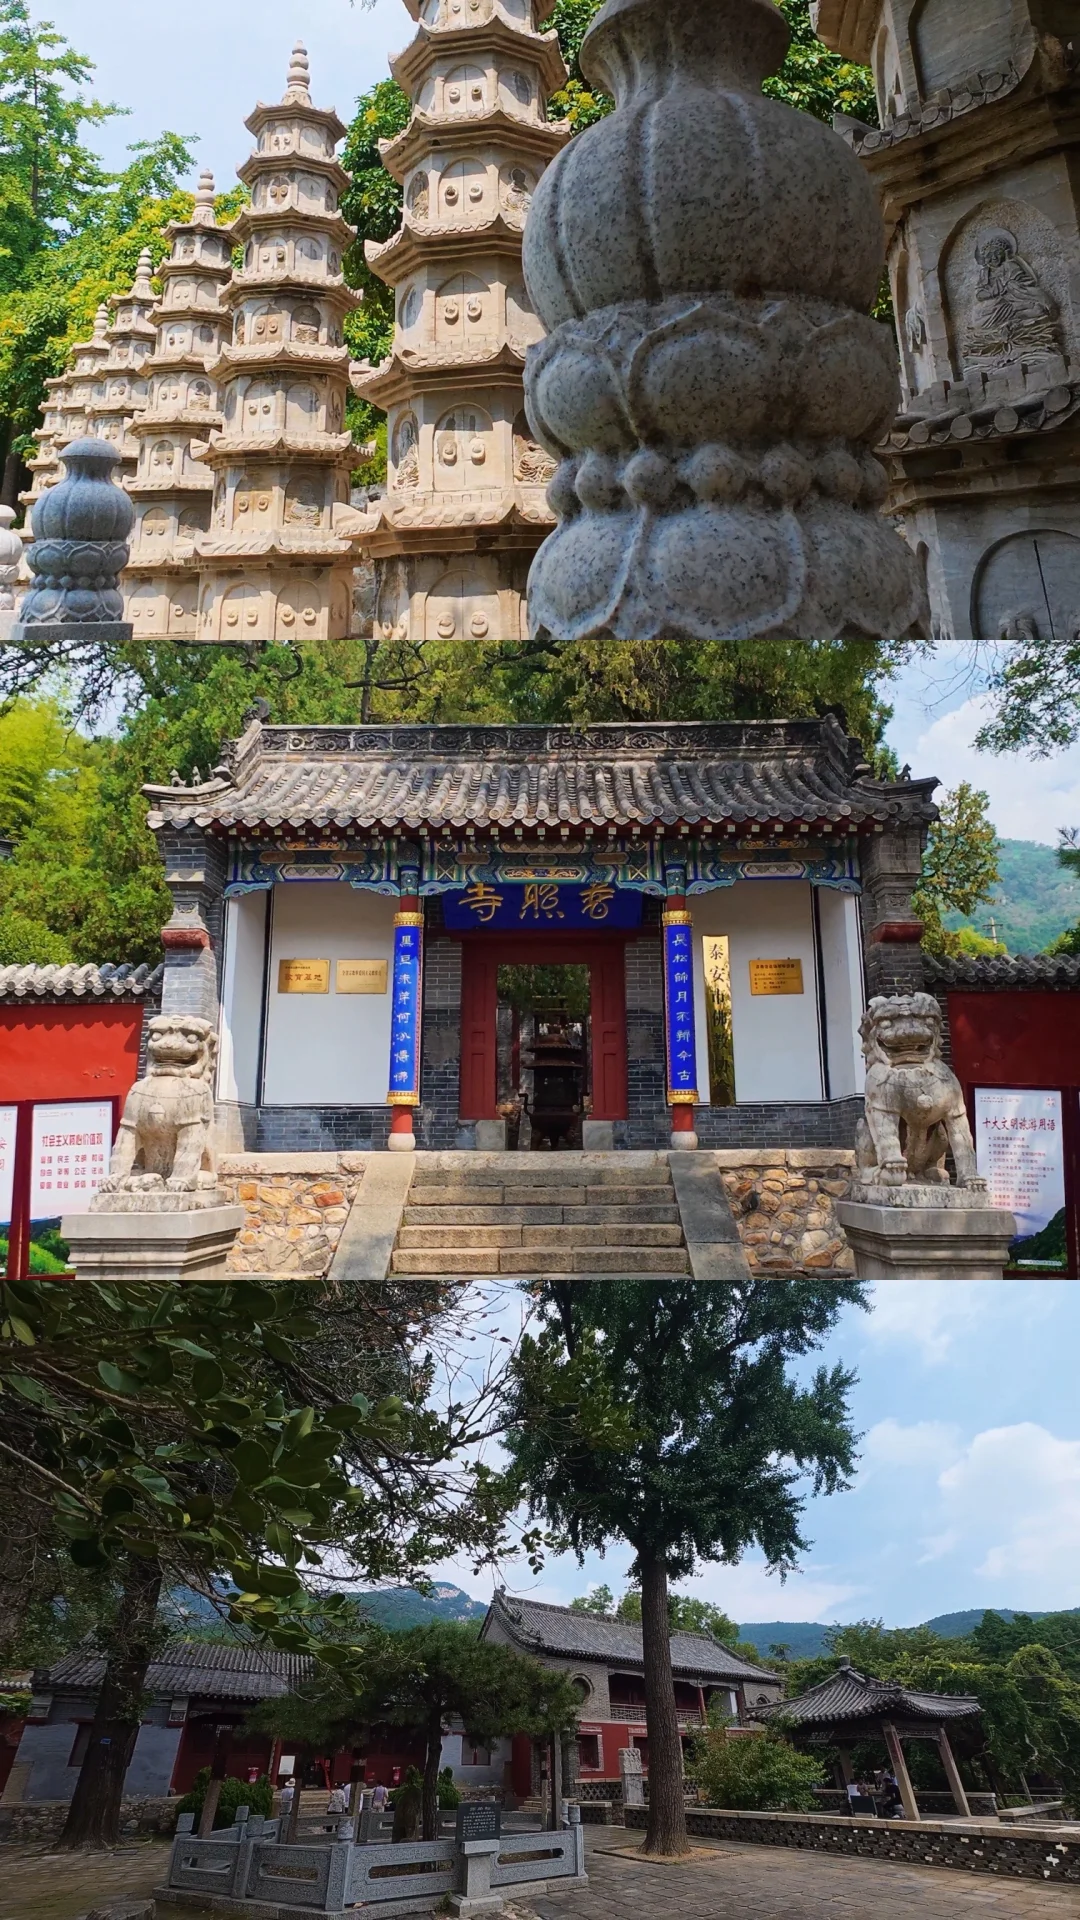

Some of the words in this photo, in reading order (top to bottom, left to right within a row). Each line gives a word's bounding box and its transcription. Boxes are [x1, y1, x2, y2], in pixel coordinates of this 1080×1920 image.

[982, 1116, 1056, 1131] 十大文明旅游用语
[42, 1133, 103, 1147] 社会主义核心价值观
